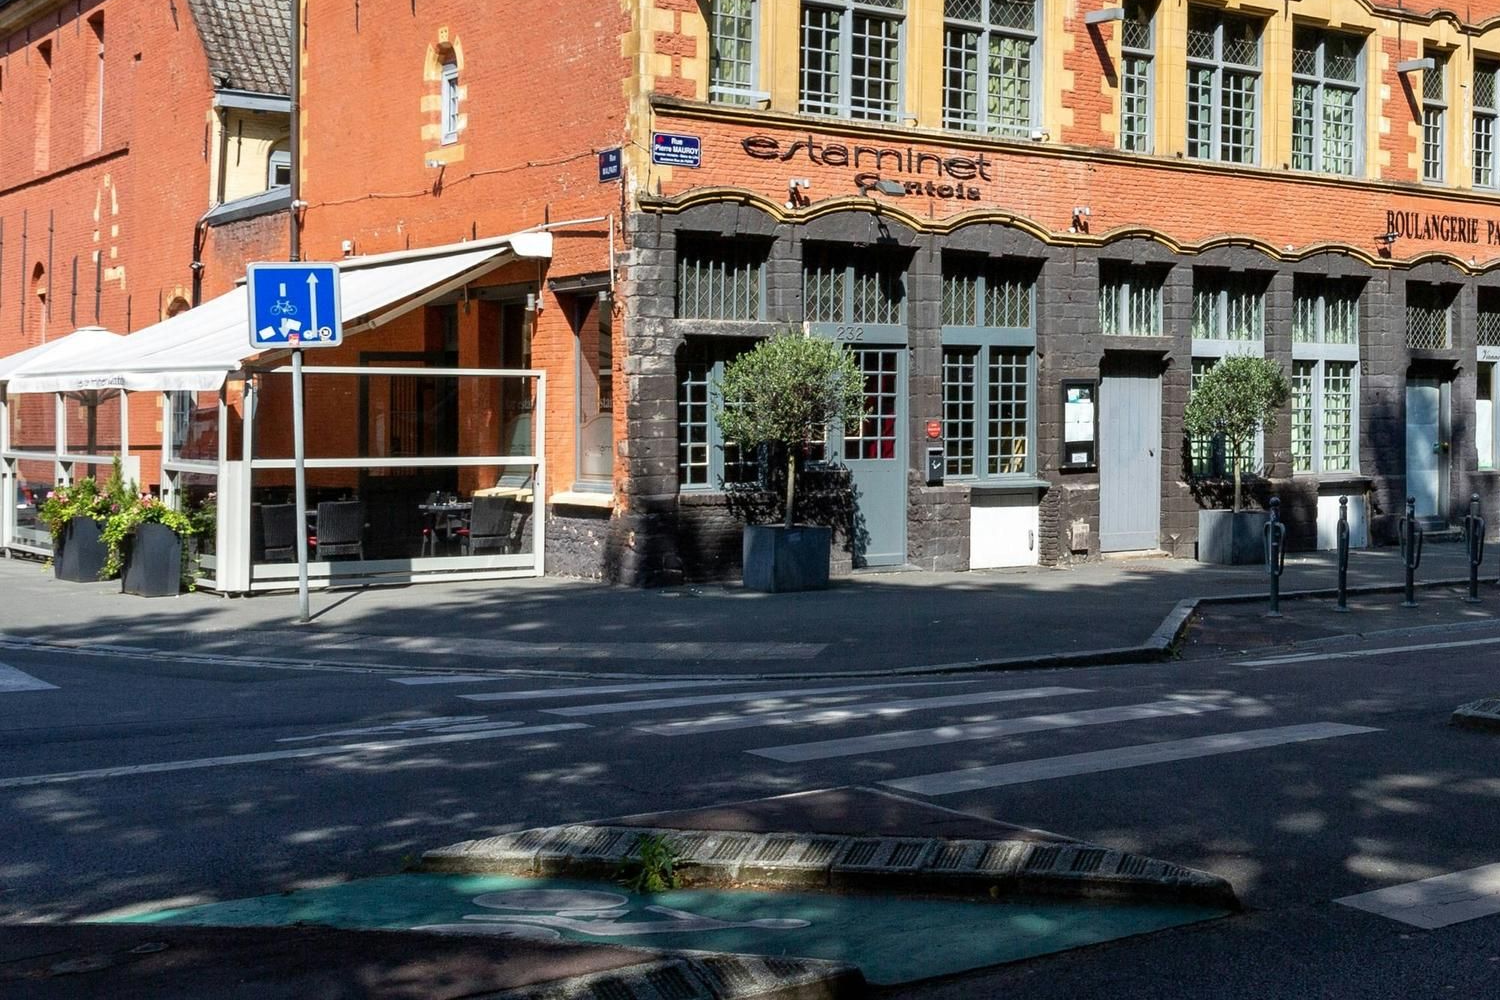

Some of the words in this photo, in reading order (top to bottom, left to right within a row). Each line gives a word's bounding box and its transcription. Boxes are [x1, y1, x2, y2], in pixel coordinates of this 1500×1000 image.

[655, 144, 672, 153] Pierre
[672, 145, 698, 155] MAUROY
[671, 137, 683, 146] Rue
[741, 135, 991, 181] estaminet
[854, 172, 981, 200] Gntois
[1386, 210, 1479, 244] BOULANGERIE
[836, 326, 864, 341] 232
